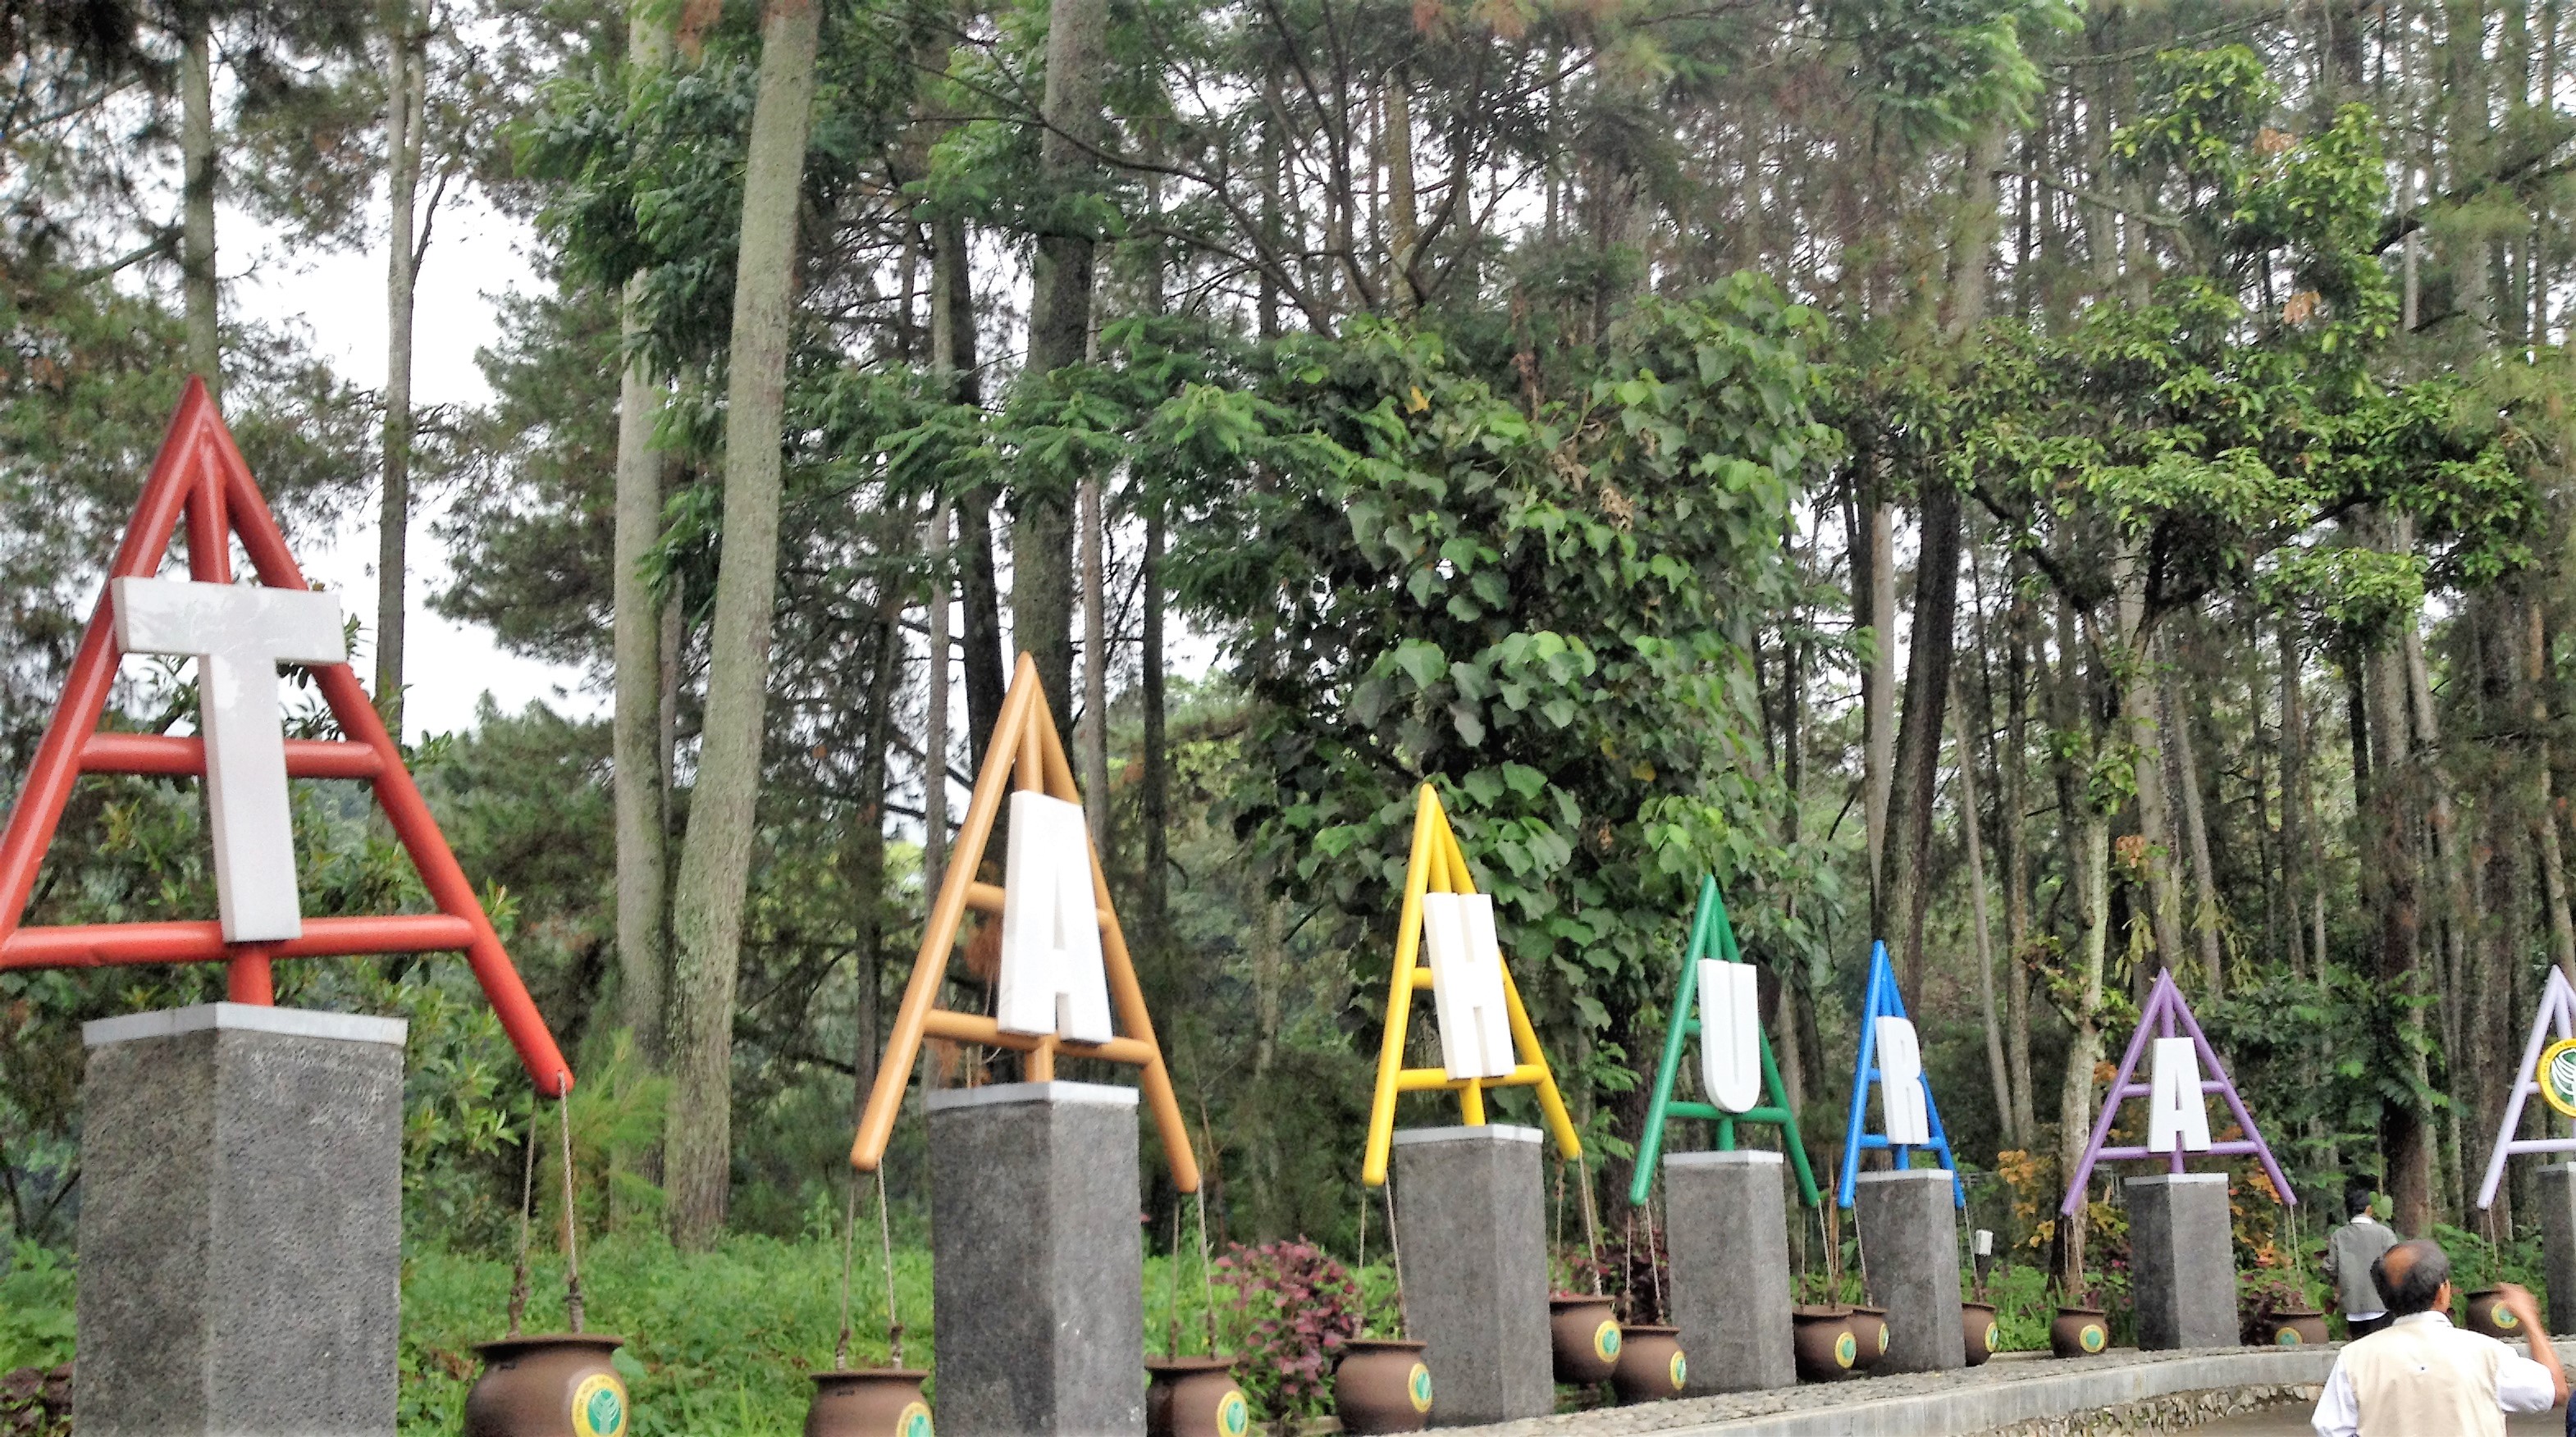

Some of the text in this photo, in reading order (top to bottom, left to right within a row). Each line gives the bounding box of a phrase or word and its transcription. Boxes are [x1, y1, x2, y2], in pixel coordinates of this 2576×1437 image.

[112, 577, 347, 942] T
[998, 790, 1113, 1043] A
[1422, 892, 1515, 1080] H
[1697, 958, 1761, 1113] U
[1875, 1016, 1930, 1144] R
[2149, 1037, 2212, 1152] A
